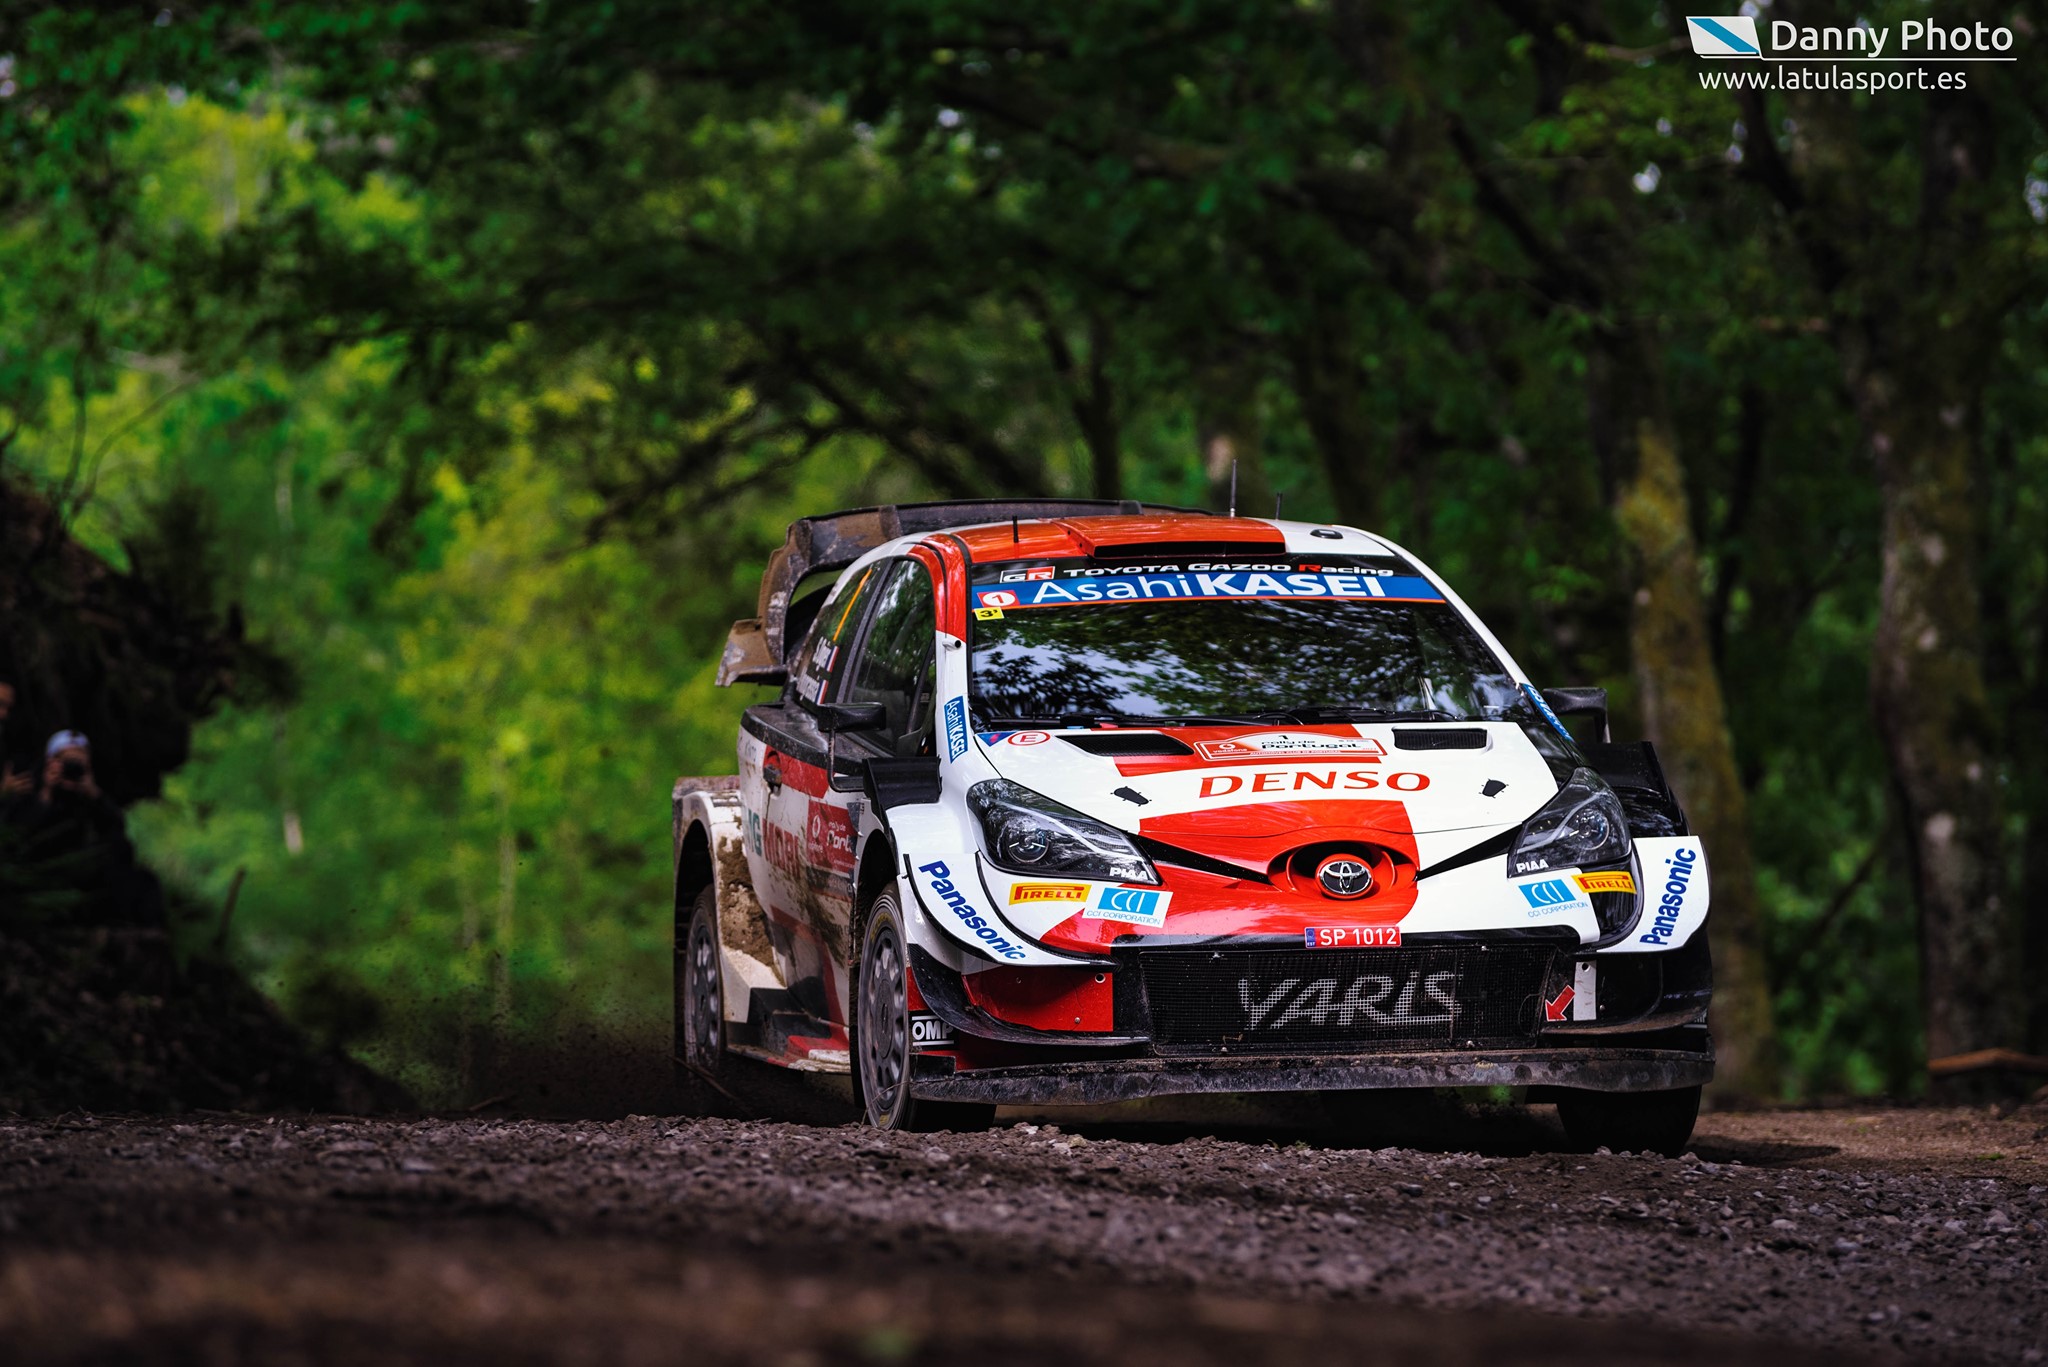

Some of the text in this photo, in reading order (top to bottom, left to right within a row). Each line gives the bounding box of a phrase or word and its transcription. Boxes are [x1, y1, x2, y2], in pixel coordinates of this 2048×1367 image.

[1003, 569, 1053, 583] GR
[1063, 563, 1395, 577] TOYOTA GAZOO Racing
[1032, 573, 1386, 604] AsahiKASEI
[992, 595, 1005, 604] 1
[1020, 734, 1038, 742] E
[1199, 771, 1431, 799] DENSO
[1109, 867, 1150, 880] PIAA
[1516, 859, 1549, 873] PIAA
[1578, 875, 1633, 890] PIRELLI
[1014, 885, 1085, 900] PIRELLI
[1640, 847, 1696, 945] Panasonic
[918, 860, 1026, 960] Panasonic
[1541, 901, 1589, 915] CORPORATION
[1103, 911, 1161, 925] CORPORATION
[1320, 928, 1397, 946] SP 1012
[1237, 971, 1462, 1031] YARIS
[912, 1021, 954, 1040] OMP
